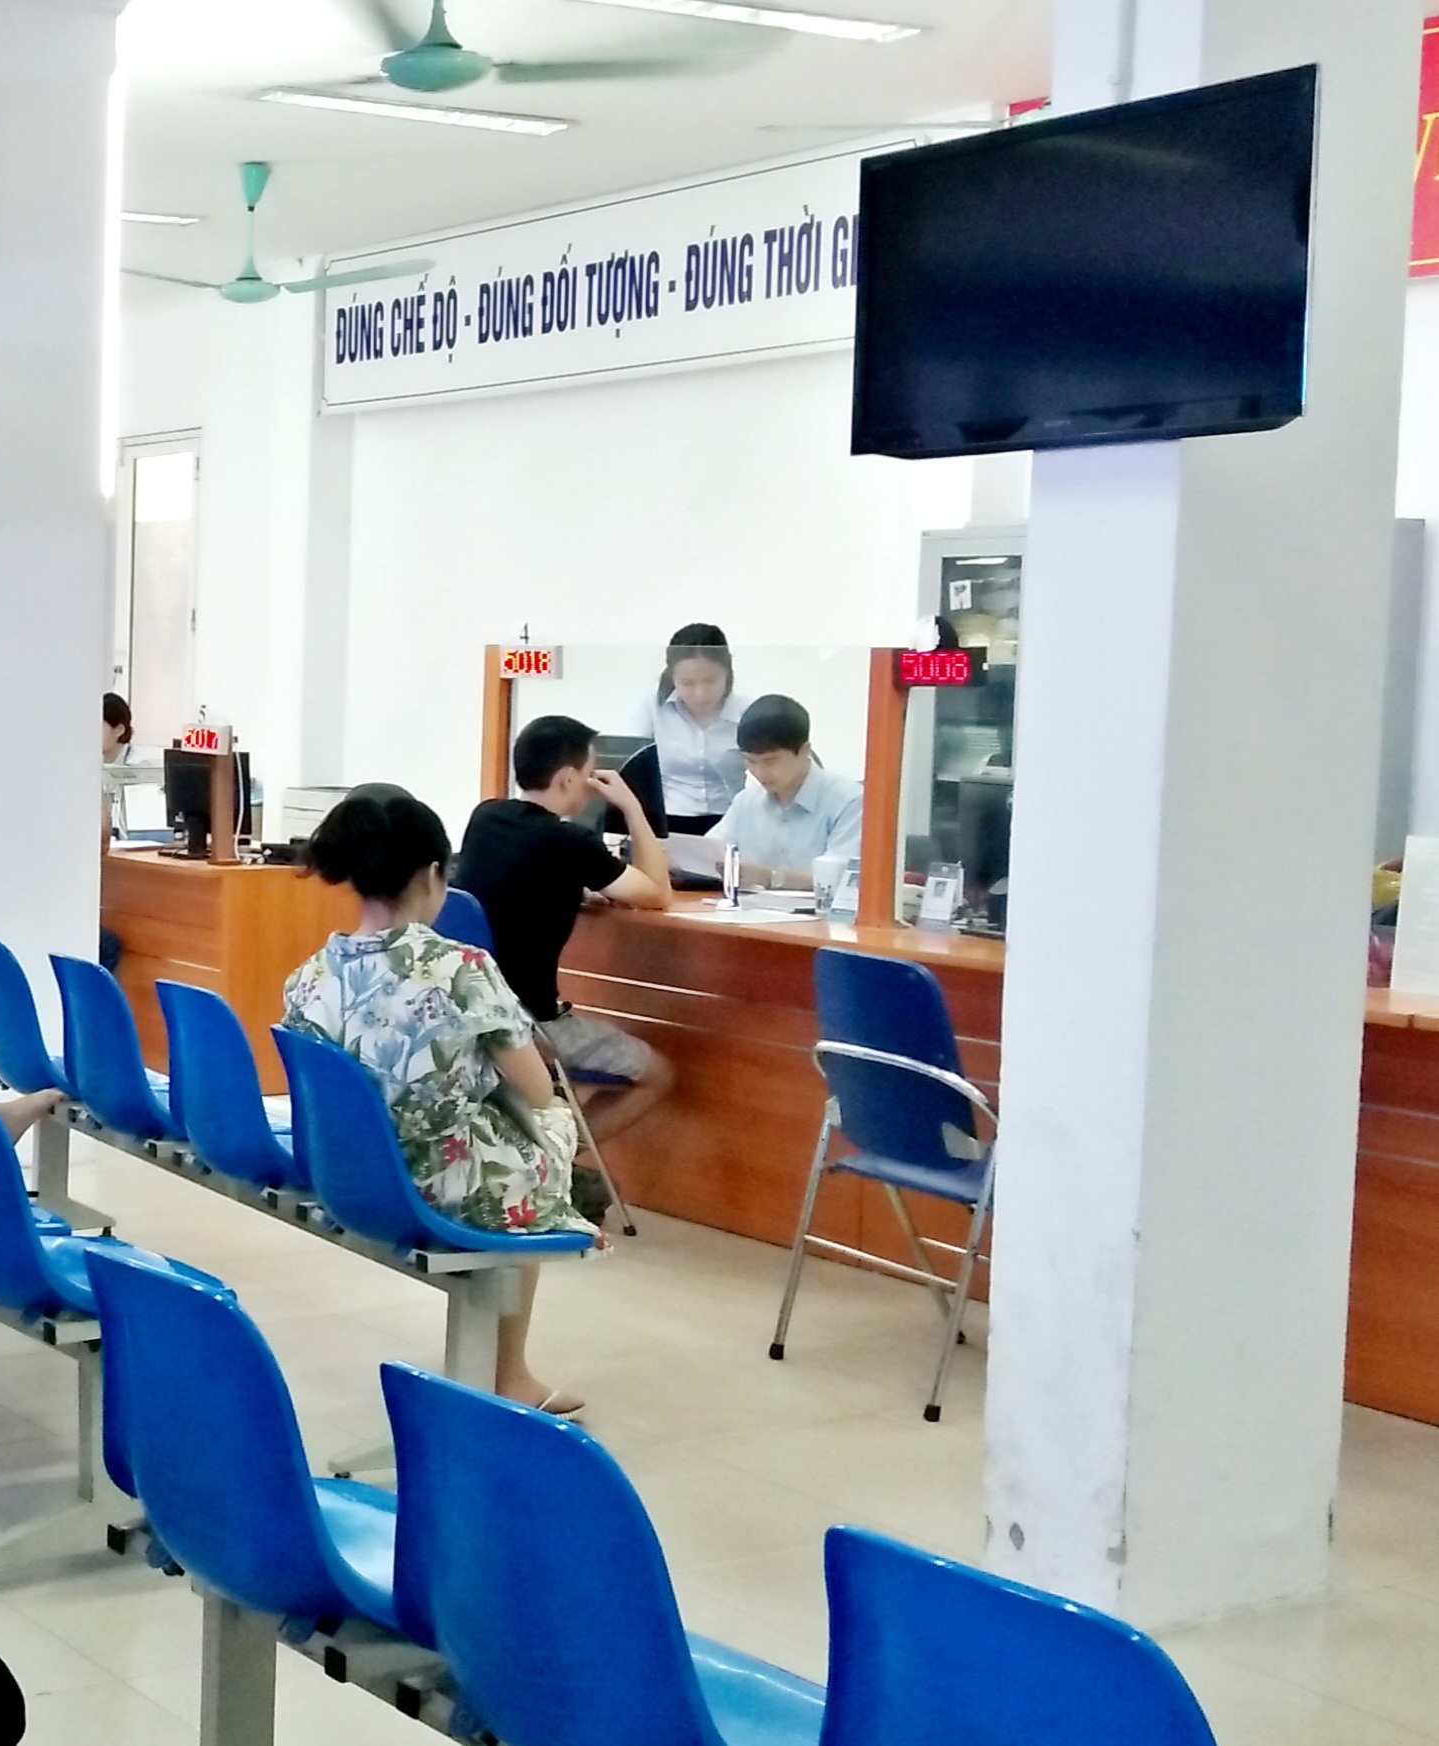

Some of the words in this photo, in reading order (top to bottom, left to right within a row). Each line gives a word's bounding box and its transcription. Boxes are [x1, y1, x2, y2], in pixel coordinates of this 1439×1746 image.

[336, 292, 384, 364] ĐÚNG
[391, 273, 428, 357] CHẾ
[432, 275, 458, 363] ĐỘ
[478, 266, 534, 344] ĐÚNG
[541, 243, 578, 334] ĐỐI
[585, 249, 660, 338] TƯỢNG
[685, 225, 754, 312] ĐÚNG
[764, 204, 822, 299] THỜI
[519, 622, 530, 645] 4
[505, 650, 551, 674] 5018
[902, 652, 969, 682] 5008
[198, 704, 207, 723] 5
